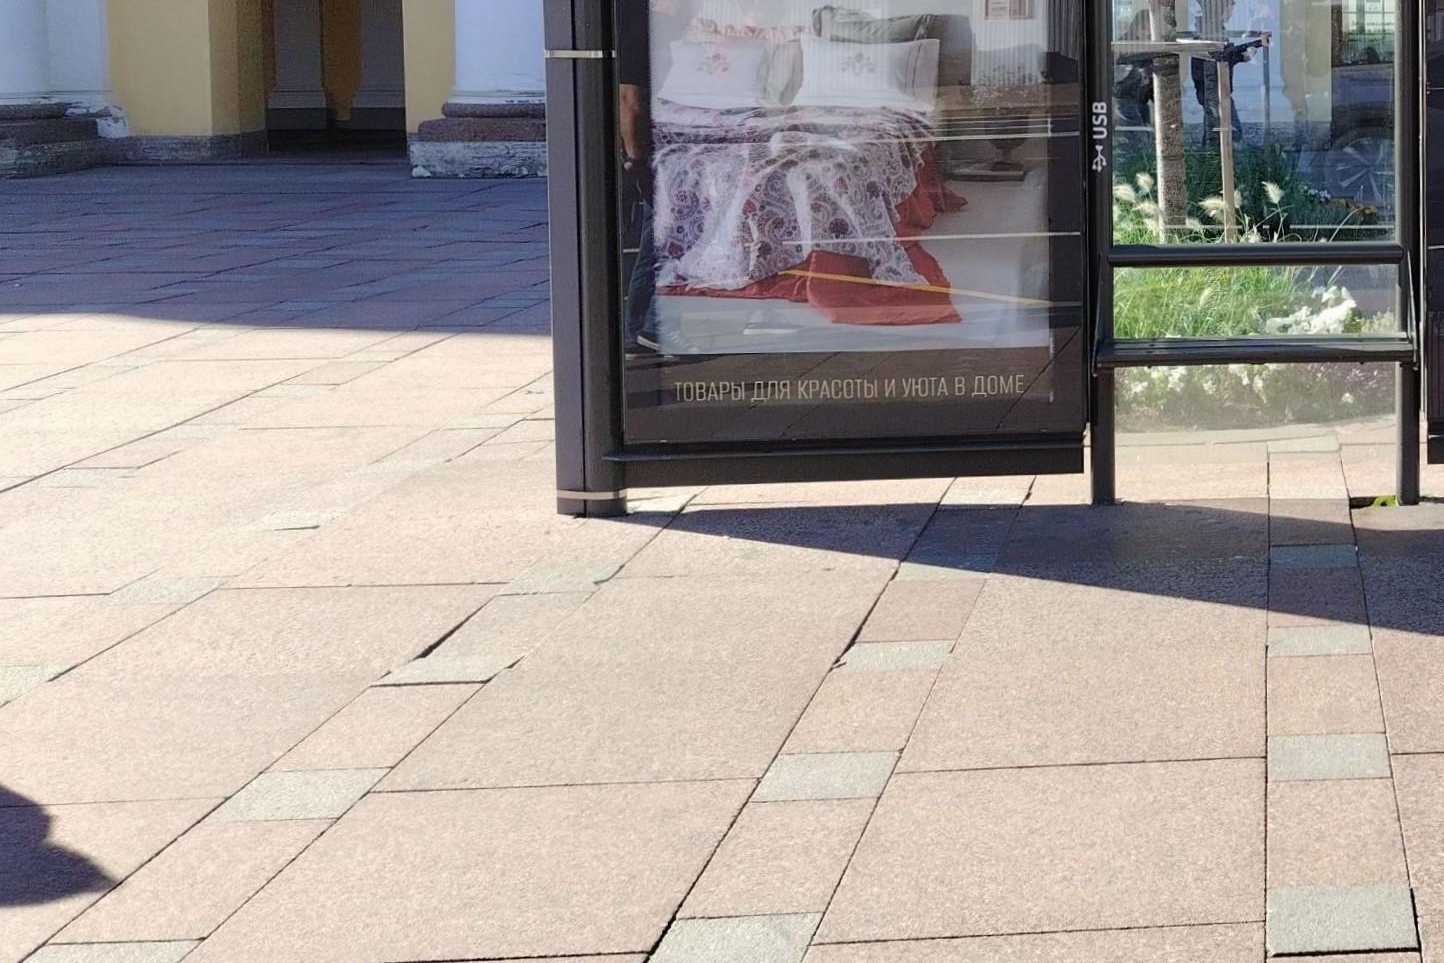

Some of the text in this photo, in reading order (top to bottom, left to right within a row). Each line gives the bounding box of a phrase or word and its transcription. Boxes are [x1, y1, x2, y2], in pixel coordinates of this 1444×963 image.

[1092, 101, 1108, 140] USB
[674, 374, 1025, 403] ТОВАРЫ ДЛЯ КРАСОТЫ И УЮТА В ДОМЕ
